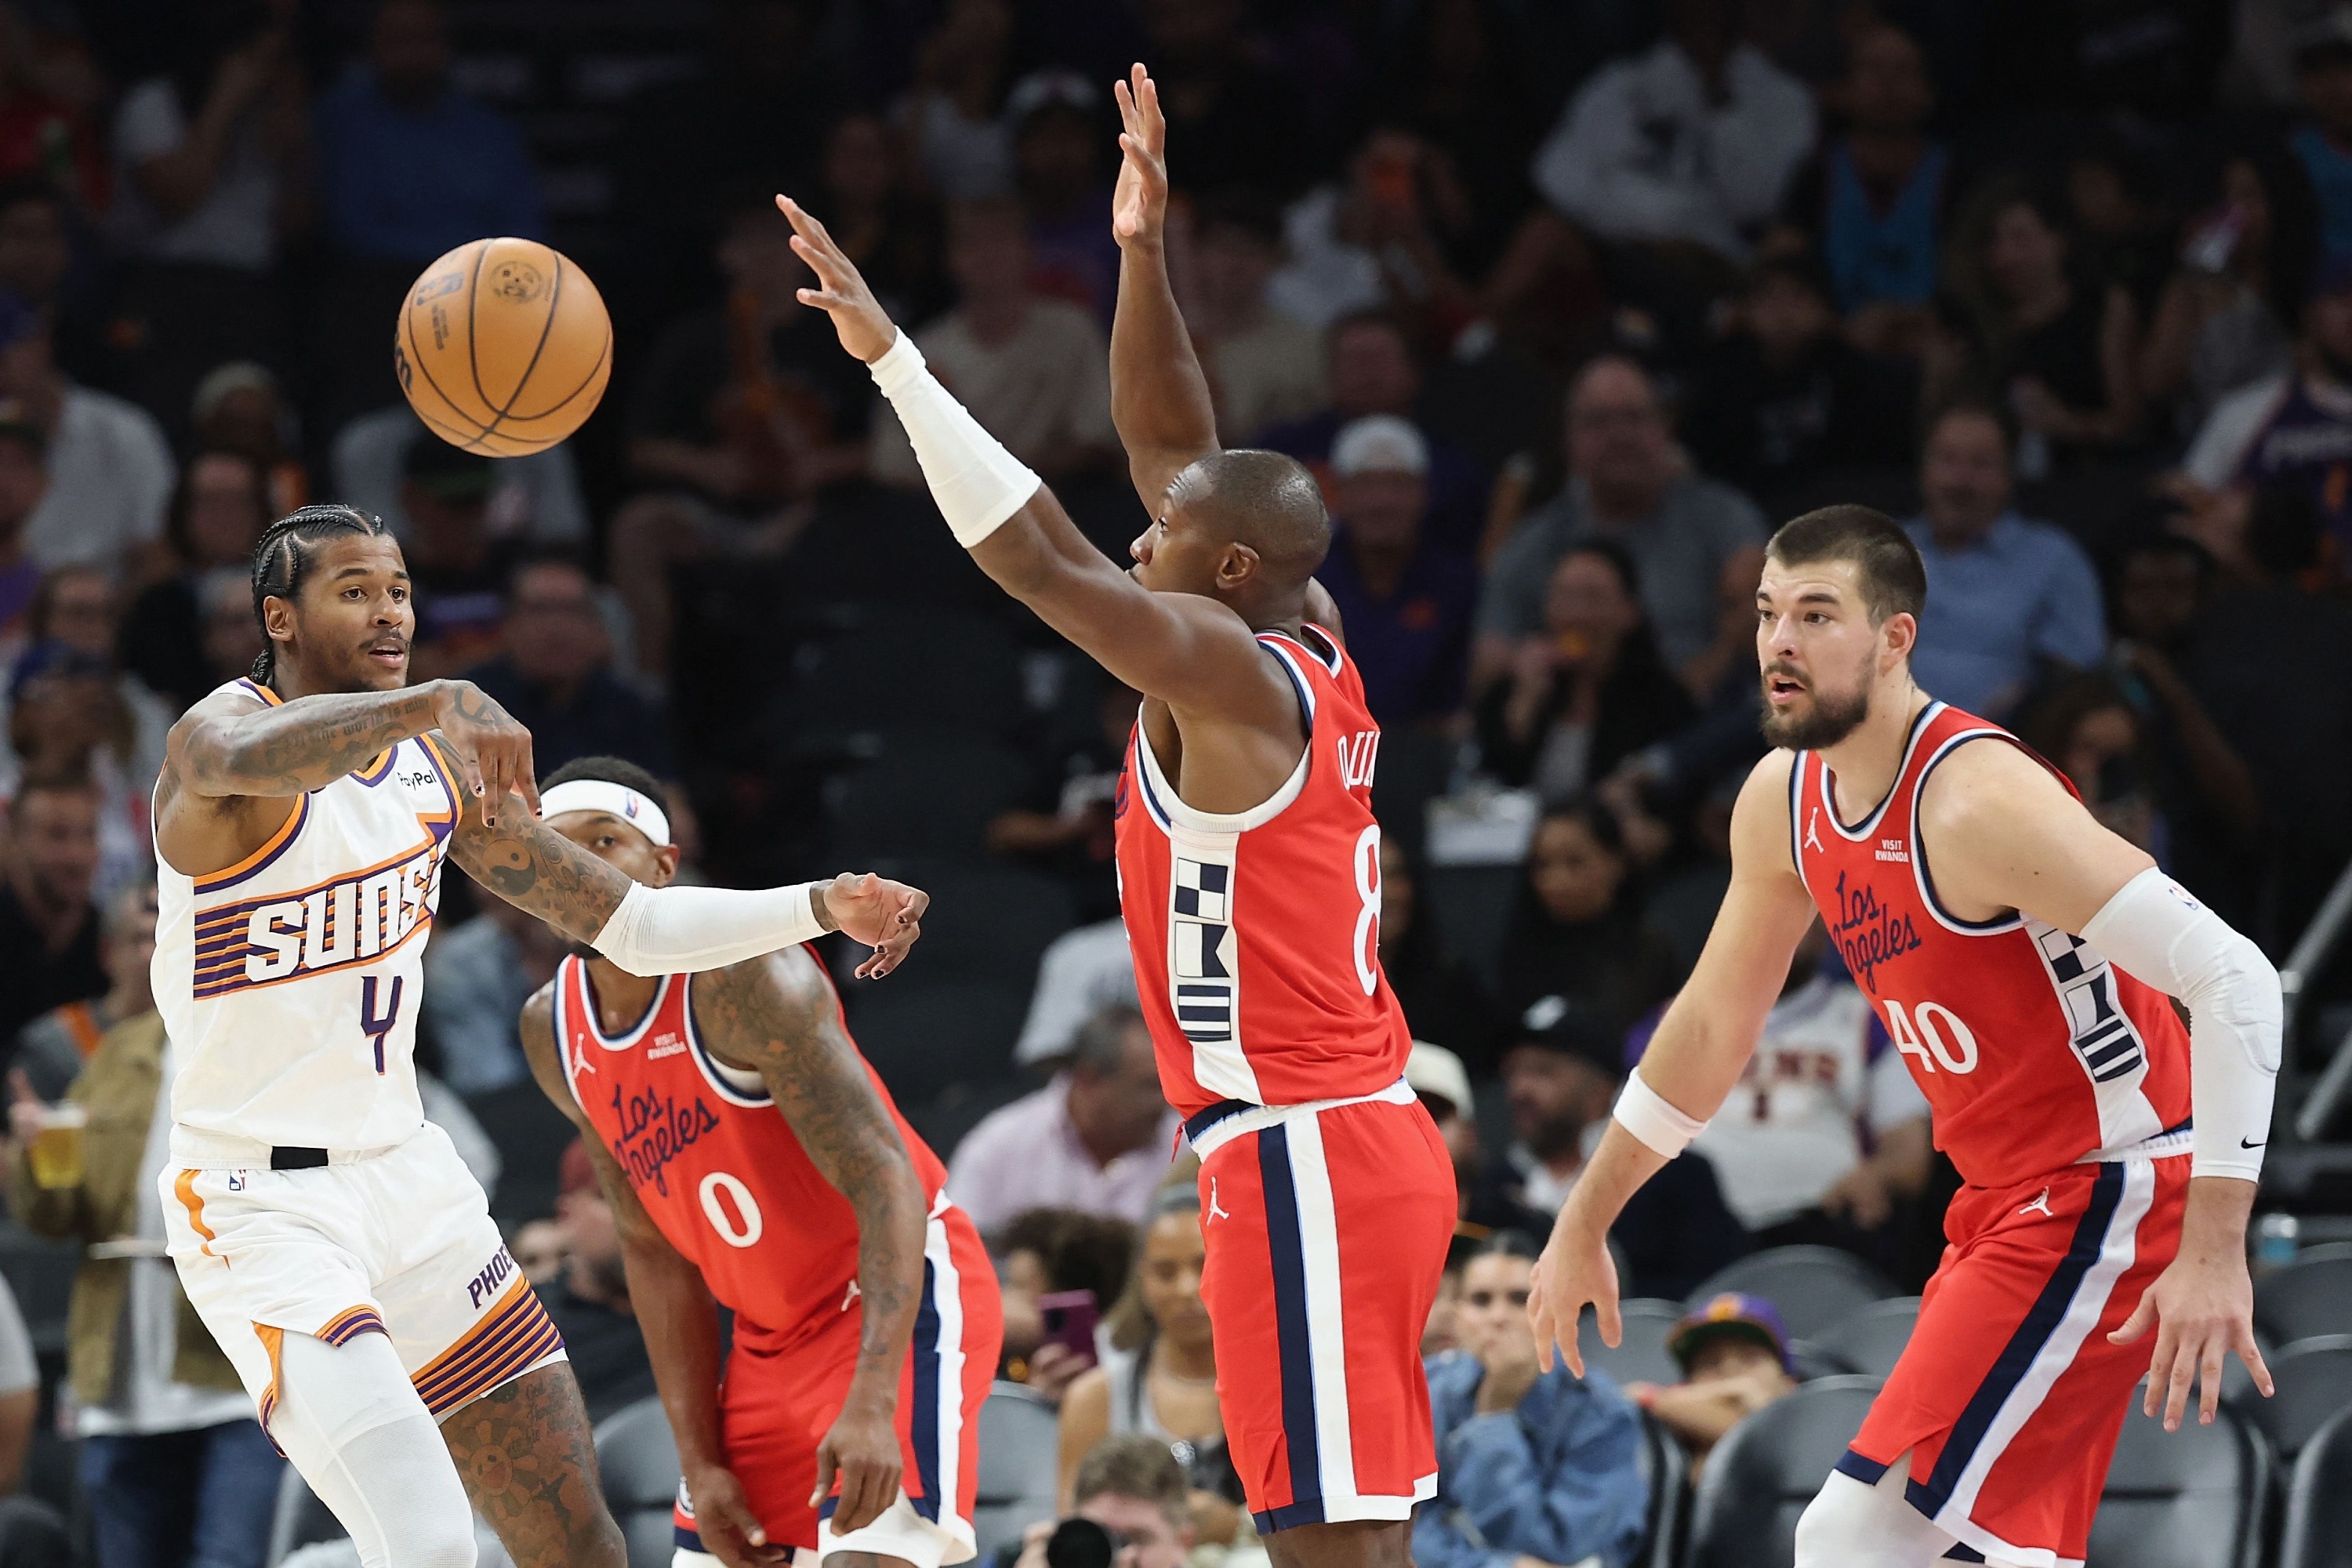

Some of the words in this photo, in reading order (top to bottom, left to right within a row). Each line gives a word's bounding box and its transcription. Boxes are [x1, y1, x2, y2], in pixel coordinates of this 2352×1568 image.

[397, 769, 437, 792] PayPal
[1875, 849, 1909, 863] RWANDA
[1882, 838, 1902, 851] VISIT
[1353, 823, 1382, 997] 8
[1835, 869, 1880, 931] Los
[360, 975, 404, 1076] 4
[1882, 999, 1979, 1076] 40
[612, 1083, 664, 1142] Los
[698, 1171, 764, 1248] 0
[466, 1243, 514, 1310] PHOE
